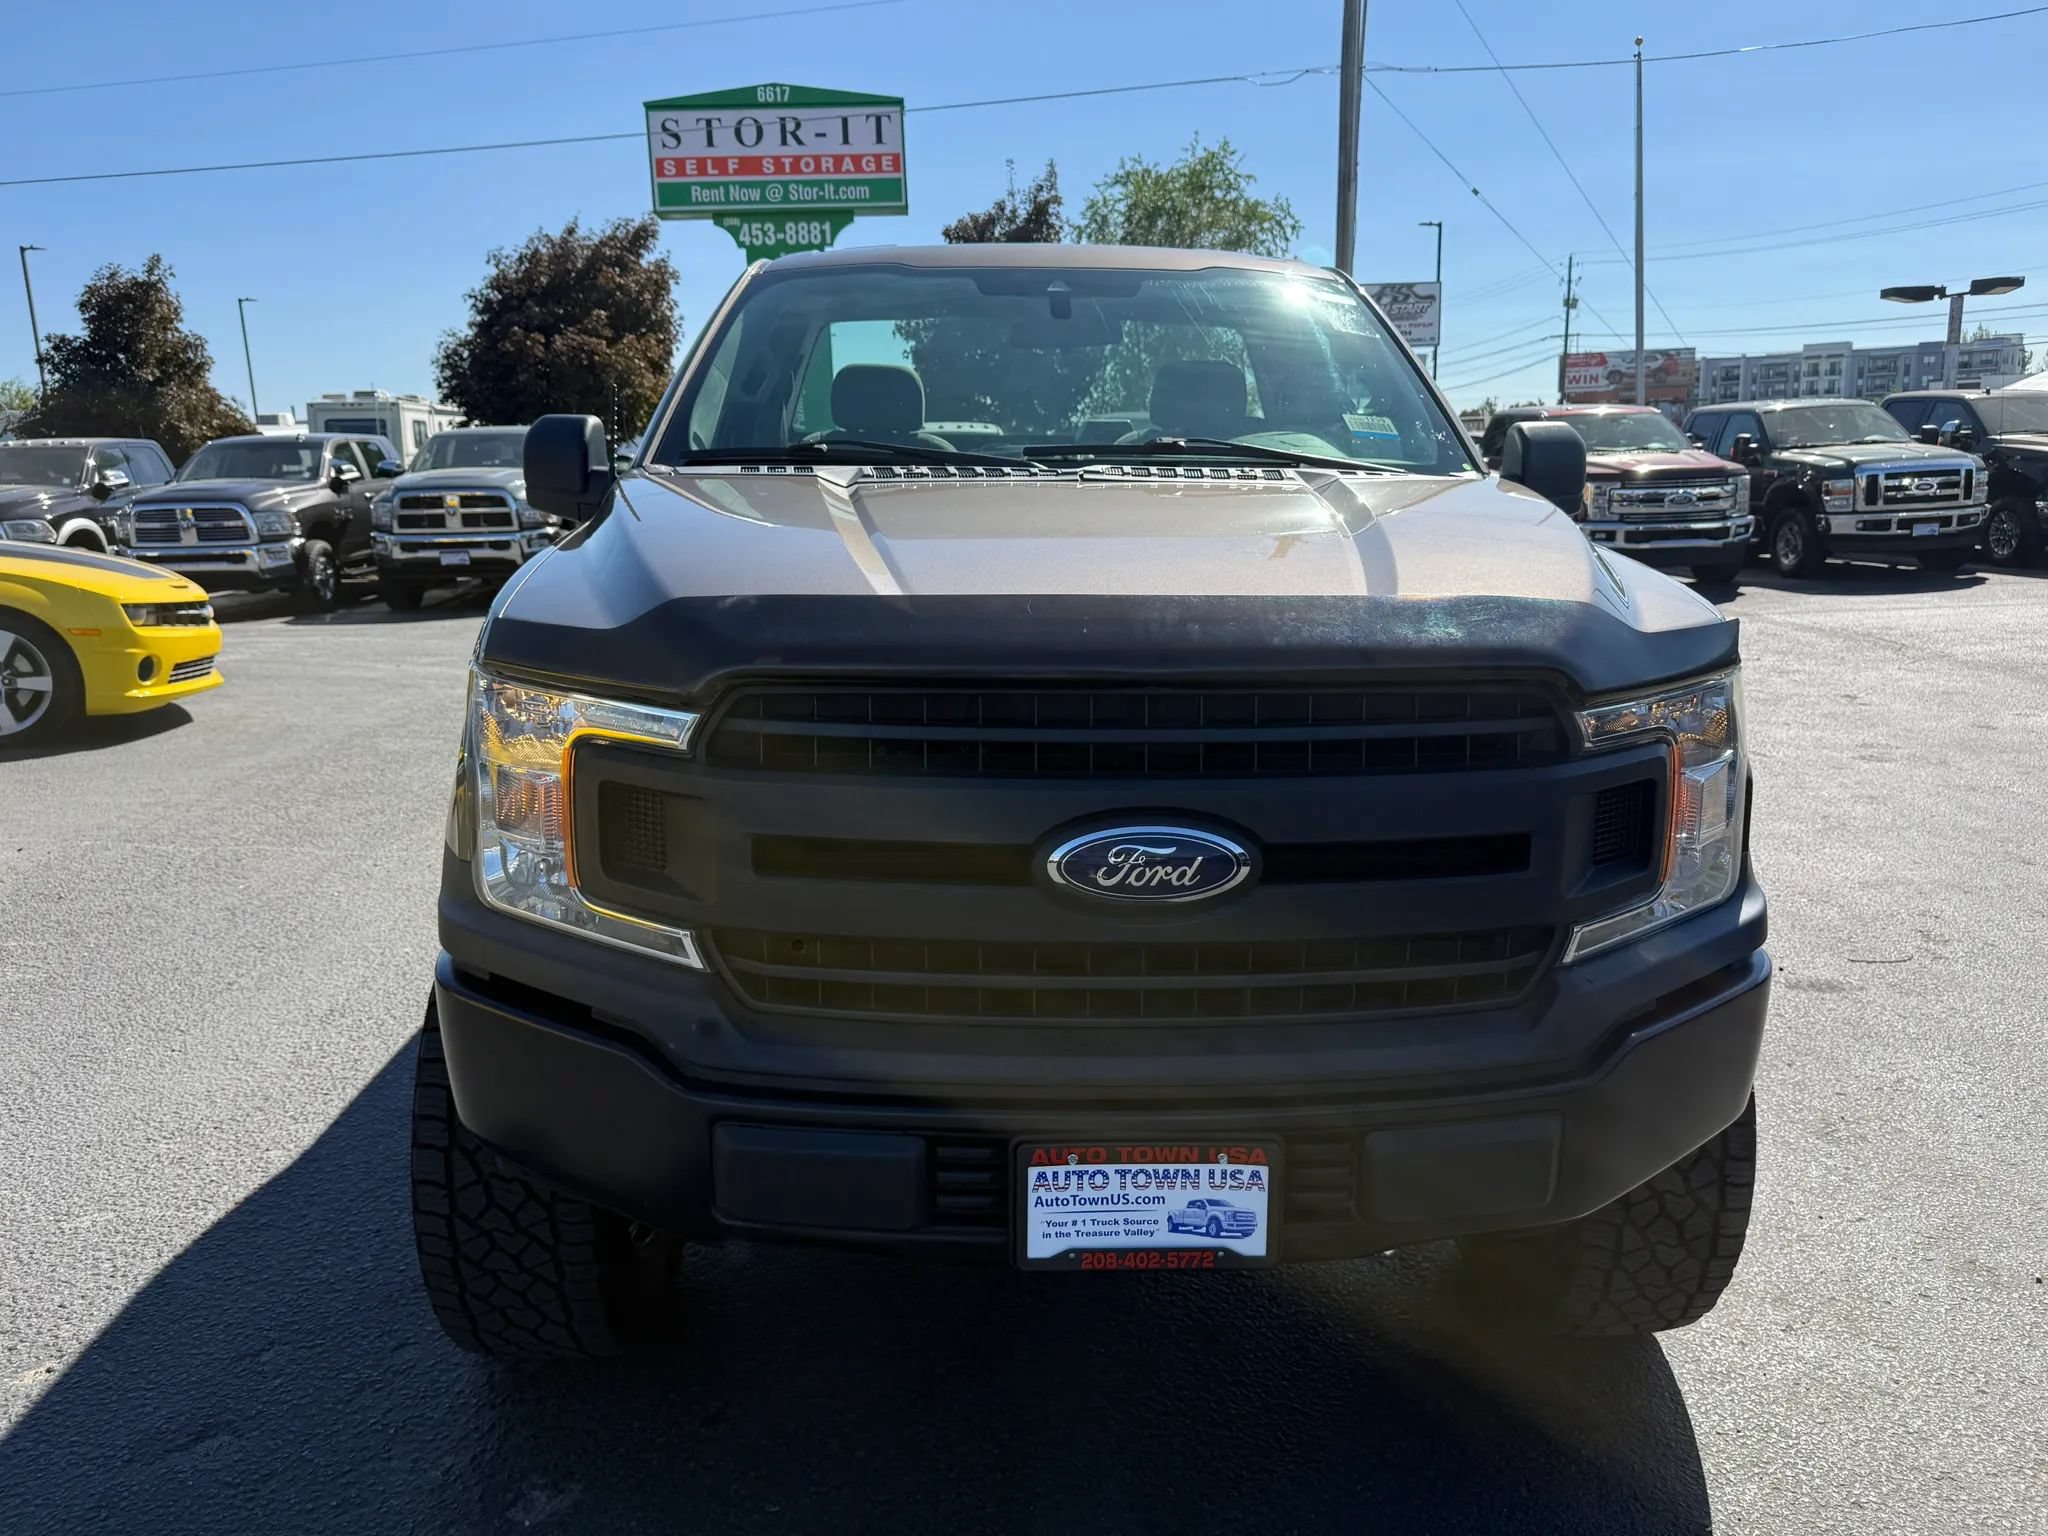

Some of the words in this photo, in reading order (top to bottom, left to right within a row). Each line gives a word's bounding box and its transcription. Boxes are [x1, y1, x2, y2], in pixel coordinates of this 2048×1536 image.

[756, 86, 791, 103] 6617
[660, 113, 893, 150] STOR-IT
[663, 158, 740, 176] SELF
[762, 155, 894, 174] STORAGE
[690, 184, 725, 203] Rent
[729, 184, 761, 202] Now
[765, 183, 784, 202] @
[788, 182, 870, 201] Stor-It.com
[739, 220, 832, 246] 453-8881
[1567, 374, 1599, 386] WIN
[1097, 844, 1203, 887] Ford
[1031, 1147, 1108, 1165] AUTO
[1117, 1147, 1199, 1164] TOWN
[1209, 1147, 1269, 1165] USA
[1031, 1168, 1110, 1193] AUTO
[1115, 1168, 1201, 1191] TOWN
[1208, 1168, 1266, 1192] USA
[1034, 1193, 1166, 1208] AutoTownUS.com
[1071, 1218, 1078, 1227] #
[1082, 1218, 1087, 1227] 1
[1090, 1217, 1120, 1227] Truck
[1122, 1217, 1159, 1226] Source
[1042, 1230, 1052, 1239] in
[1054, 1230, 1071, 1239] the
[1074, 1229, 1121, 1238] Treasure
[1080, 1251, 1215, 1270] 208-402-5772
